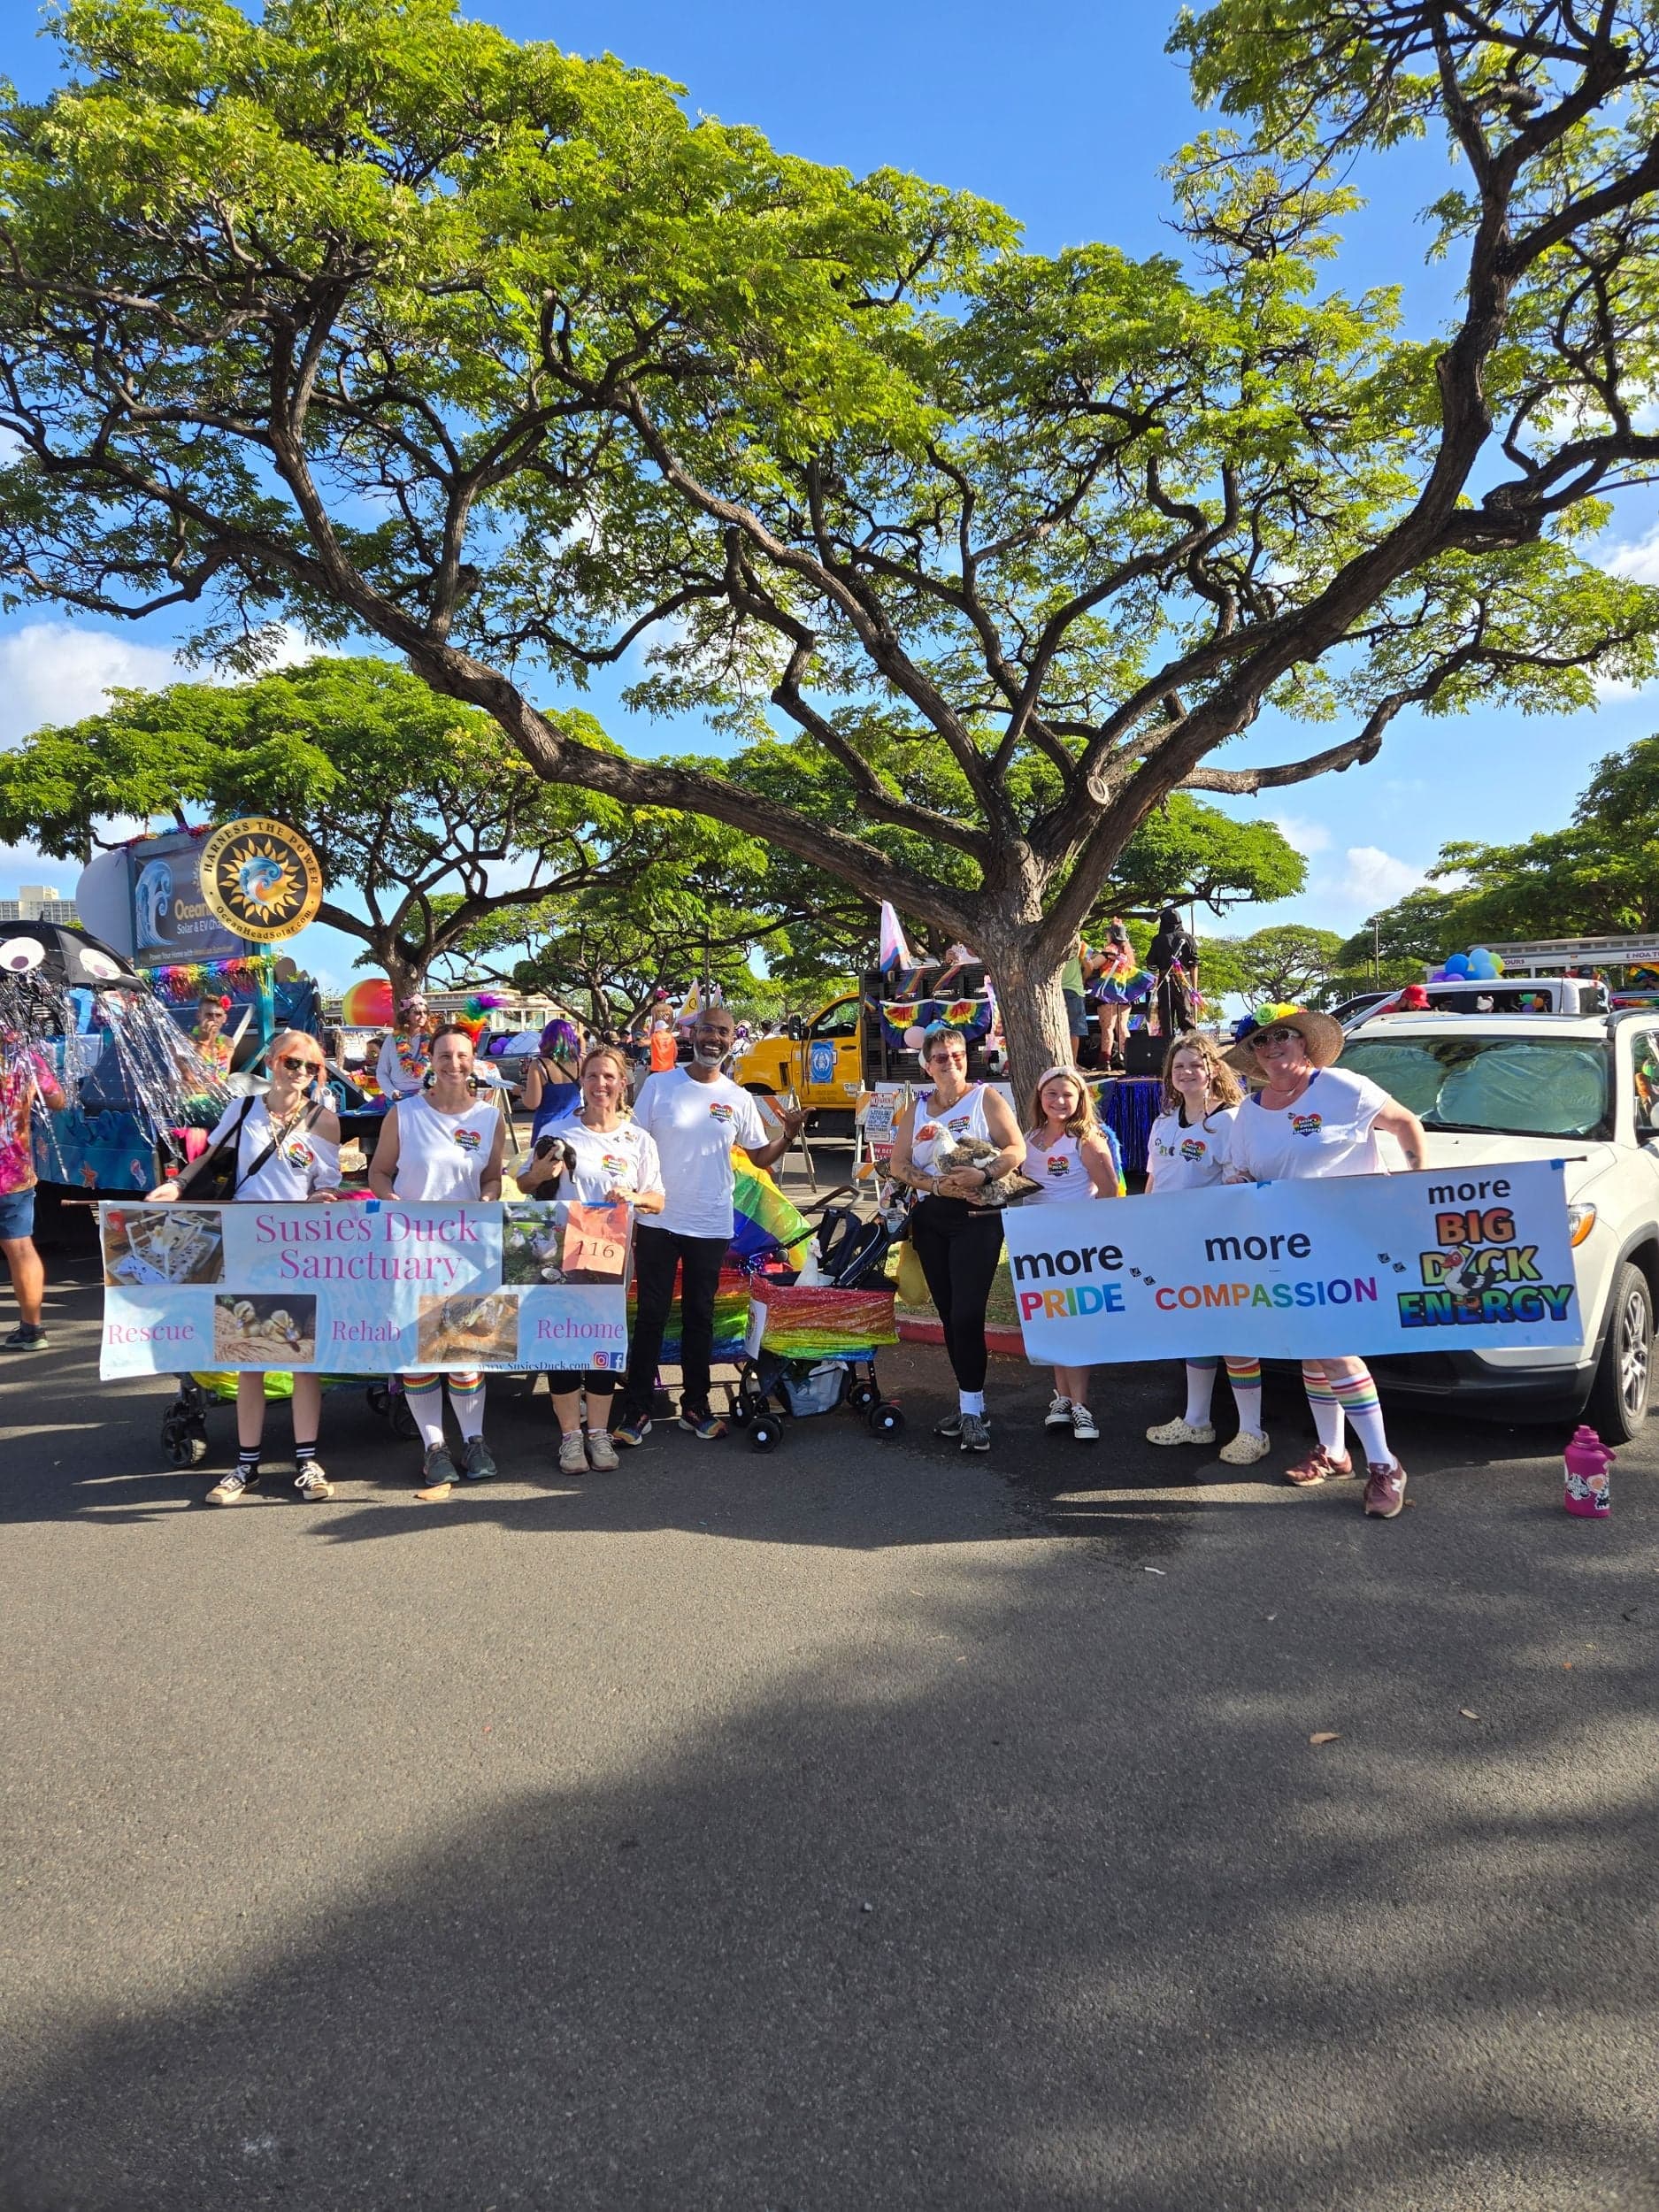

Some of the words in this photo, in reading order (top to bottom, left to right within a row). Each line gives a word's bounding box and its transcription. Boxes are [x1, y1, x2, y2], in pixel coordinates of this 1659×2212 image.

[204, 822, 250, 873] HARNESS
[257, 821, 284, 837] THE
[288, 835, 319, 885] POWER
[174, 899, 212, 921] Ocean
[177, 923, 194, 934] Solar
[194, 922, 199, 933] &
[199, 920, 208, 932] EV
[216, 905, 312, 940] OceanHeadSolar.com
[1428, 1179, 1512, 1205] more
[383, 1210, 480, 1242] Duck
[1435, 1208, 1516, 1247] BIG
[574, 1240, 616, 1259] 116
[1013, 1244, 1124, 1280] more
[1204, 1233, 1311, 1263] more
[280, 1248, 464, 1286] Sanctuary
[1019, 1282, 1125, 1321] PRIDE
[1156, 1276, 1378, 1312] COMPASSION
[1397, 1284, 1577, 1328] ENERGY
[107, 1324, 195, 1345] Rescue
[332, 1319, 401, 1341] Rehab
[537, 1318, 625, 1339] Rehome
